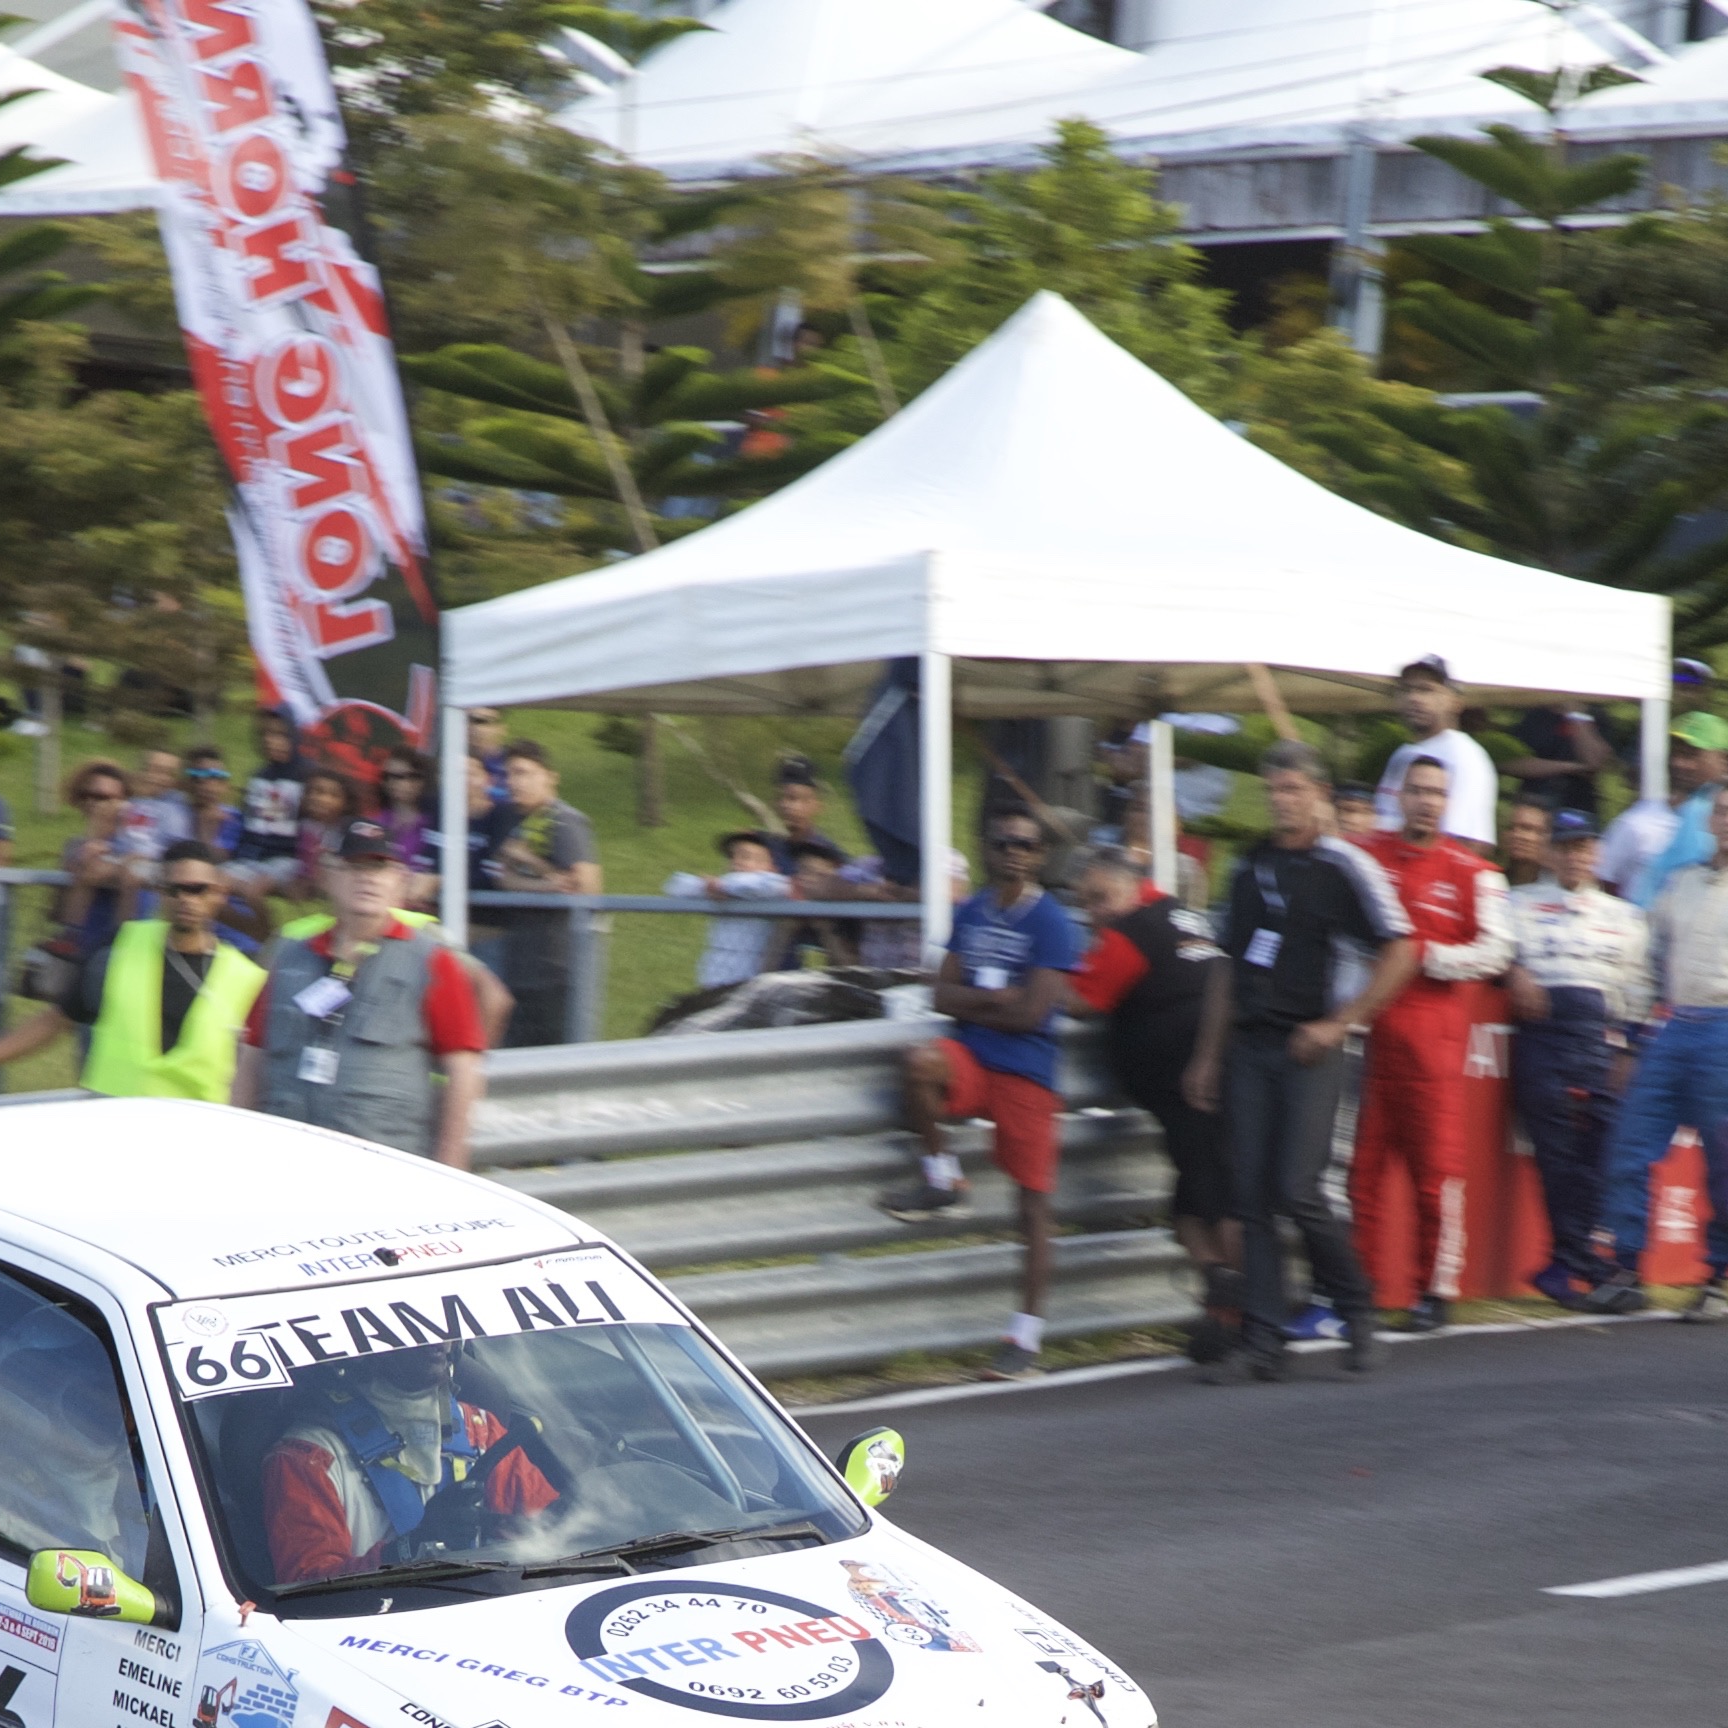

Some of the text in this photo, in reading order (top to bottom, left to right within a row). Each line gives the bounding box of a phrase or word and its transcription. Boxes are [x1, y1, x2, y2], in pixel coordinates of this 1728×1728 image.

[212, 1244, 302, 1267] MERCI
[300, 1229, 397, 1251] TOUTE
[297, 1240, 464, 1277] INTER PNEU
[236, 1294, 487, 1367] TEAM
[502, 1280, 627, 1332] ALI
[186, 1340, 272, 1387] 66
[606, 1598, 767, 1637] 0262 34 44 70
[134, 1629, 182, 1662] MERCI
[216, 1652, 274, 1677] CONSTRUCTION
[240, 1644, 259, 1660] FJ
[578, 1615, 872, 1683] INTER PNEU
[118, 1658, 183, 1699] EMELINE
[338, 1635, 629, 1706] MERCI GREG BTP
[687, 1655, 854, 1700] 0692 60 59 03
